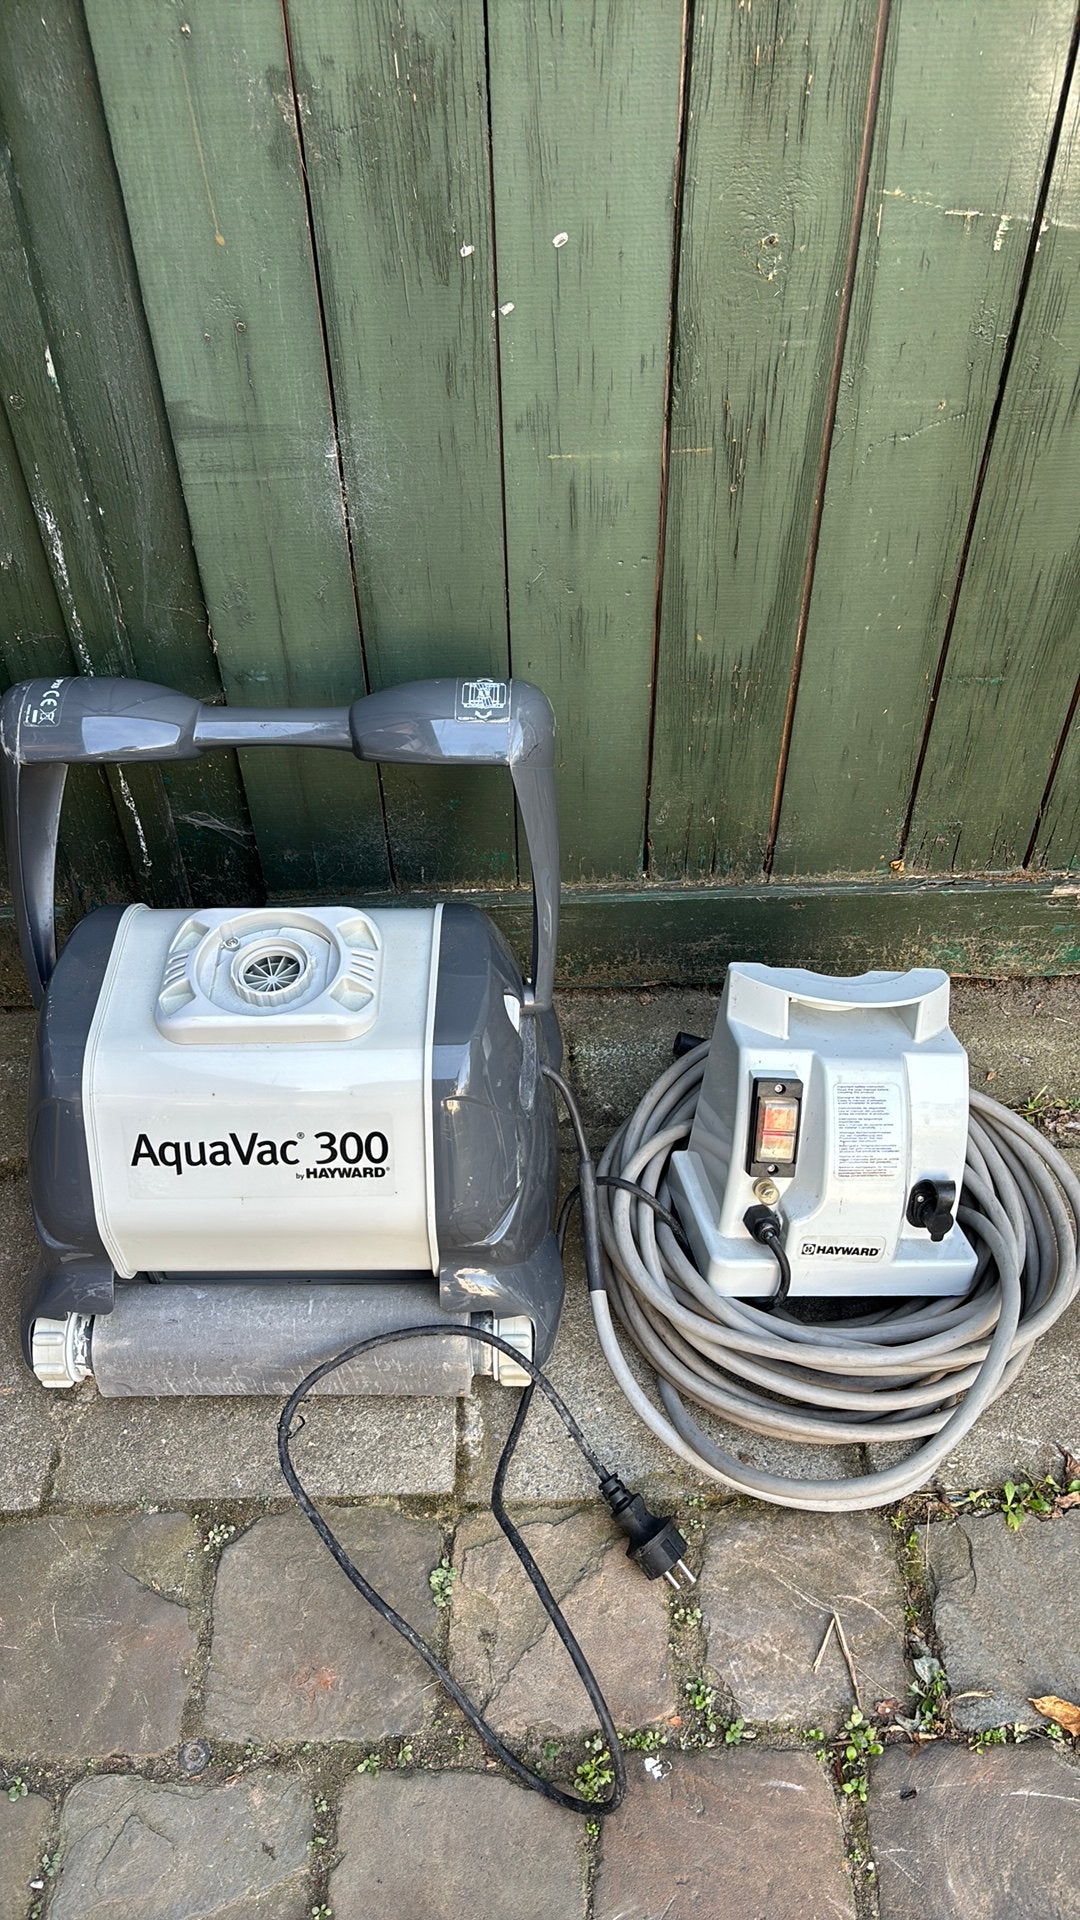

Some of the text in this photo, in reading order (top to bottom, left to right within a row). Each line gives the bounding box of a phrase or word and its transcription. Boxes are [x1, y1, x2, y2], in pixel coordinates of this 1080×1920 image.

[314, 1131, 389, 1164] 300
[305, 1167, 387, 1179] HAYWARD
[816, 1245, 879, 1257] HAYWARD
